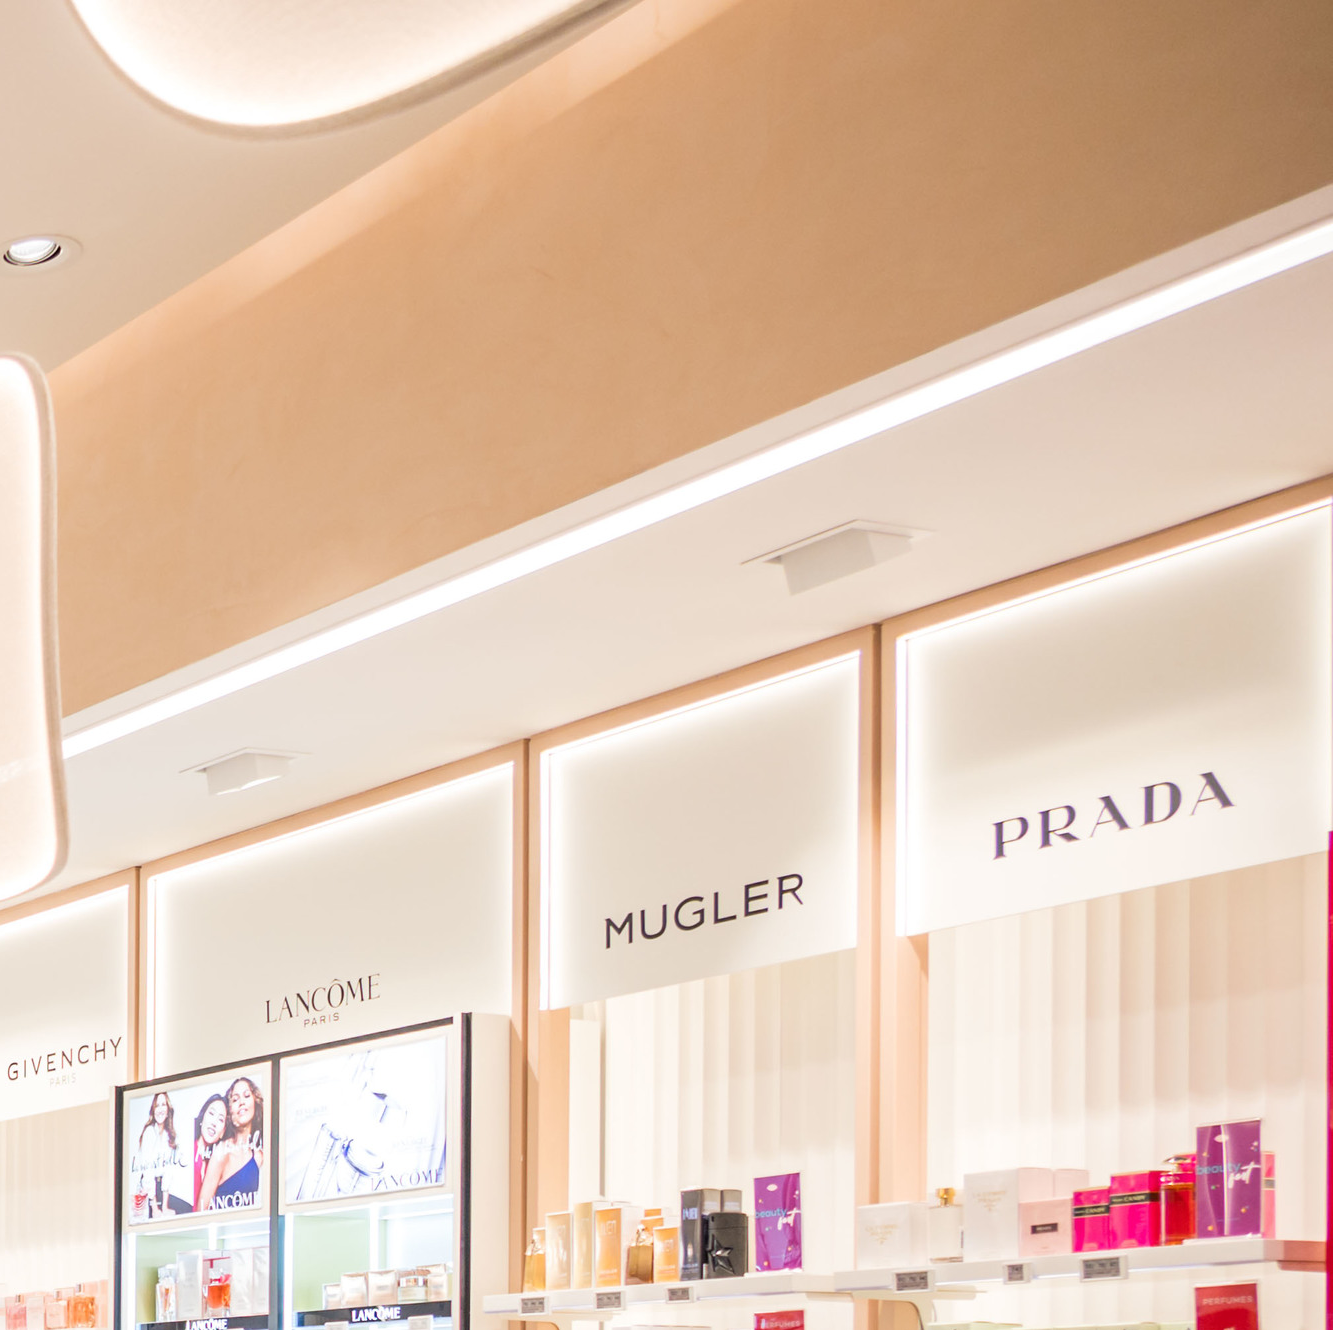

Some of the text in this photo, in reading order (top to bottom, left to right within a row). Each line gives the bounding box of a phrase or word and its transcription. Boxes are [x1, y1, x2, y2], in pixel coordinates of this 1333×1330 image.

[991, 770, 1237, 861] PRADA
[604, 873, 804, 949] MUGLER
[265, 972, 381, 1024] LANCÔME
[303, 1012, 340, 1028] PARIS
[7, 1035, 122, 1082] GIVENCHY
[755, 1207, 786, 1221] beauty
[352, 1305, 400, 1321] LANCÔME
